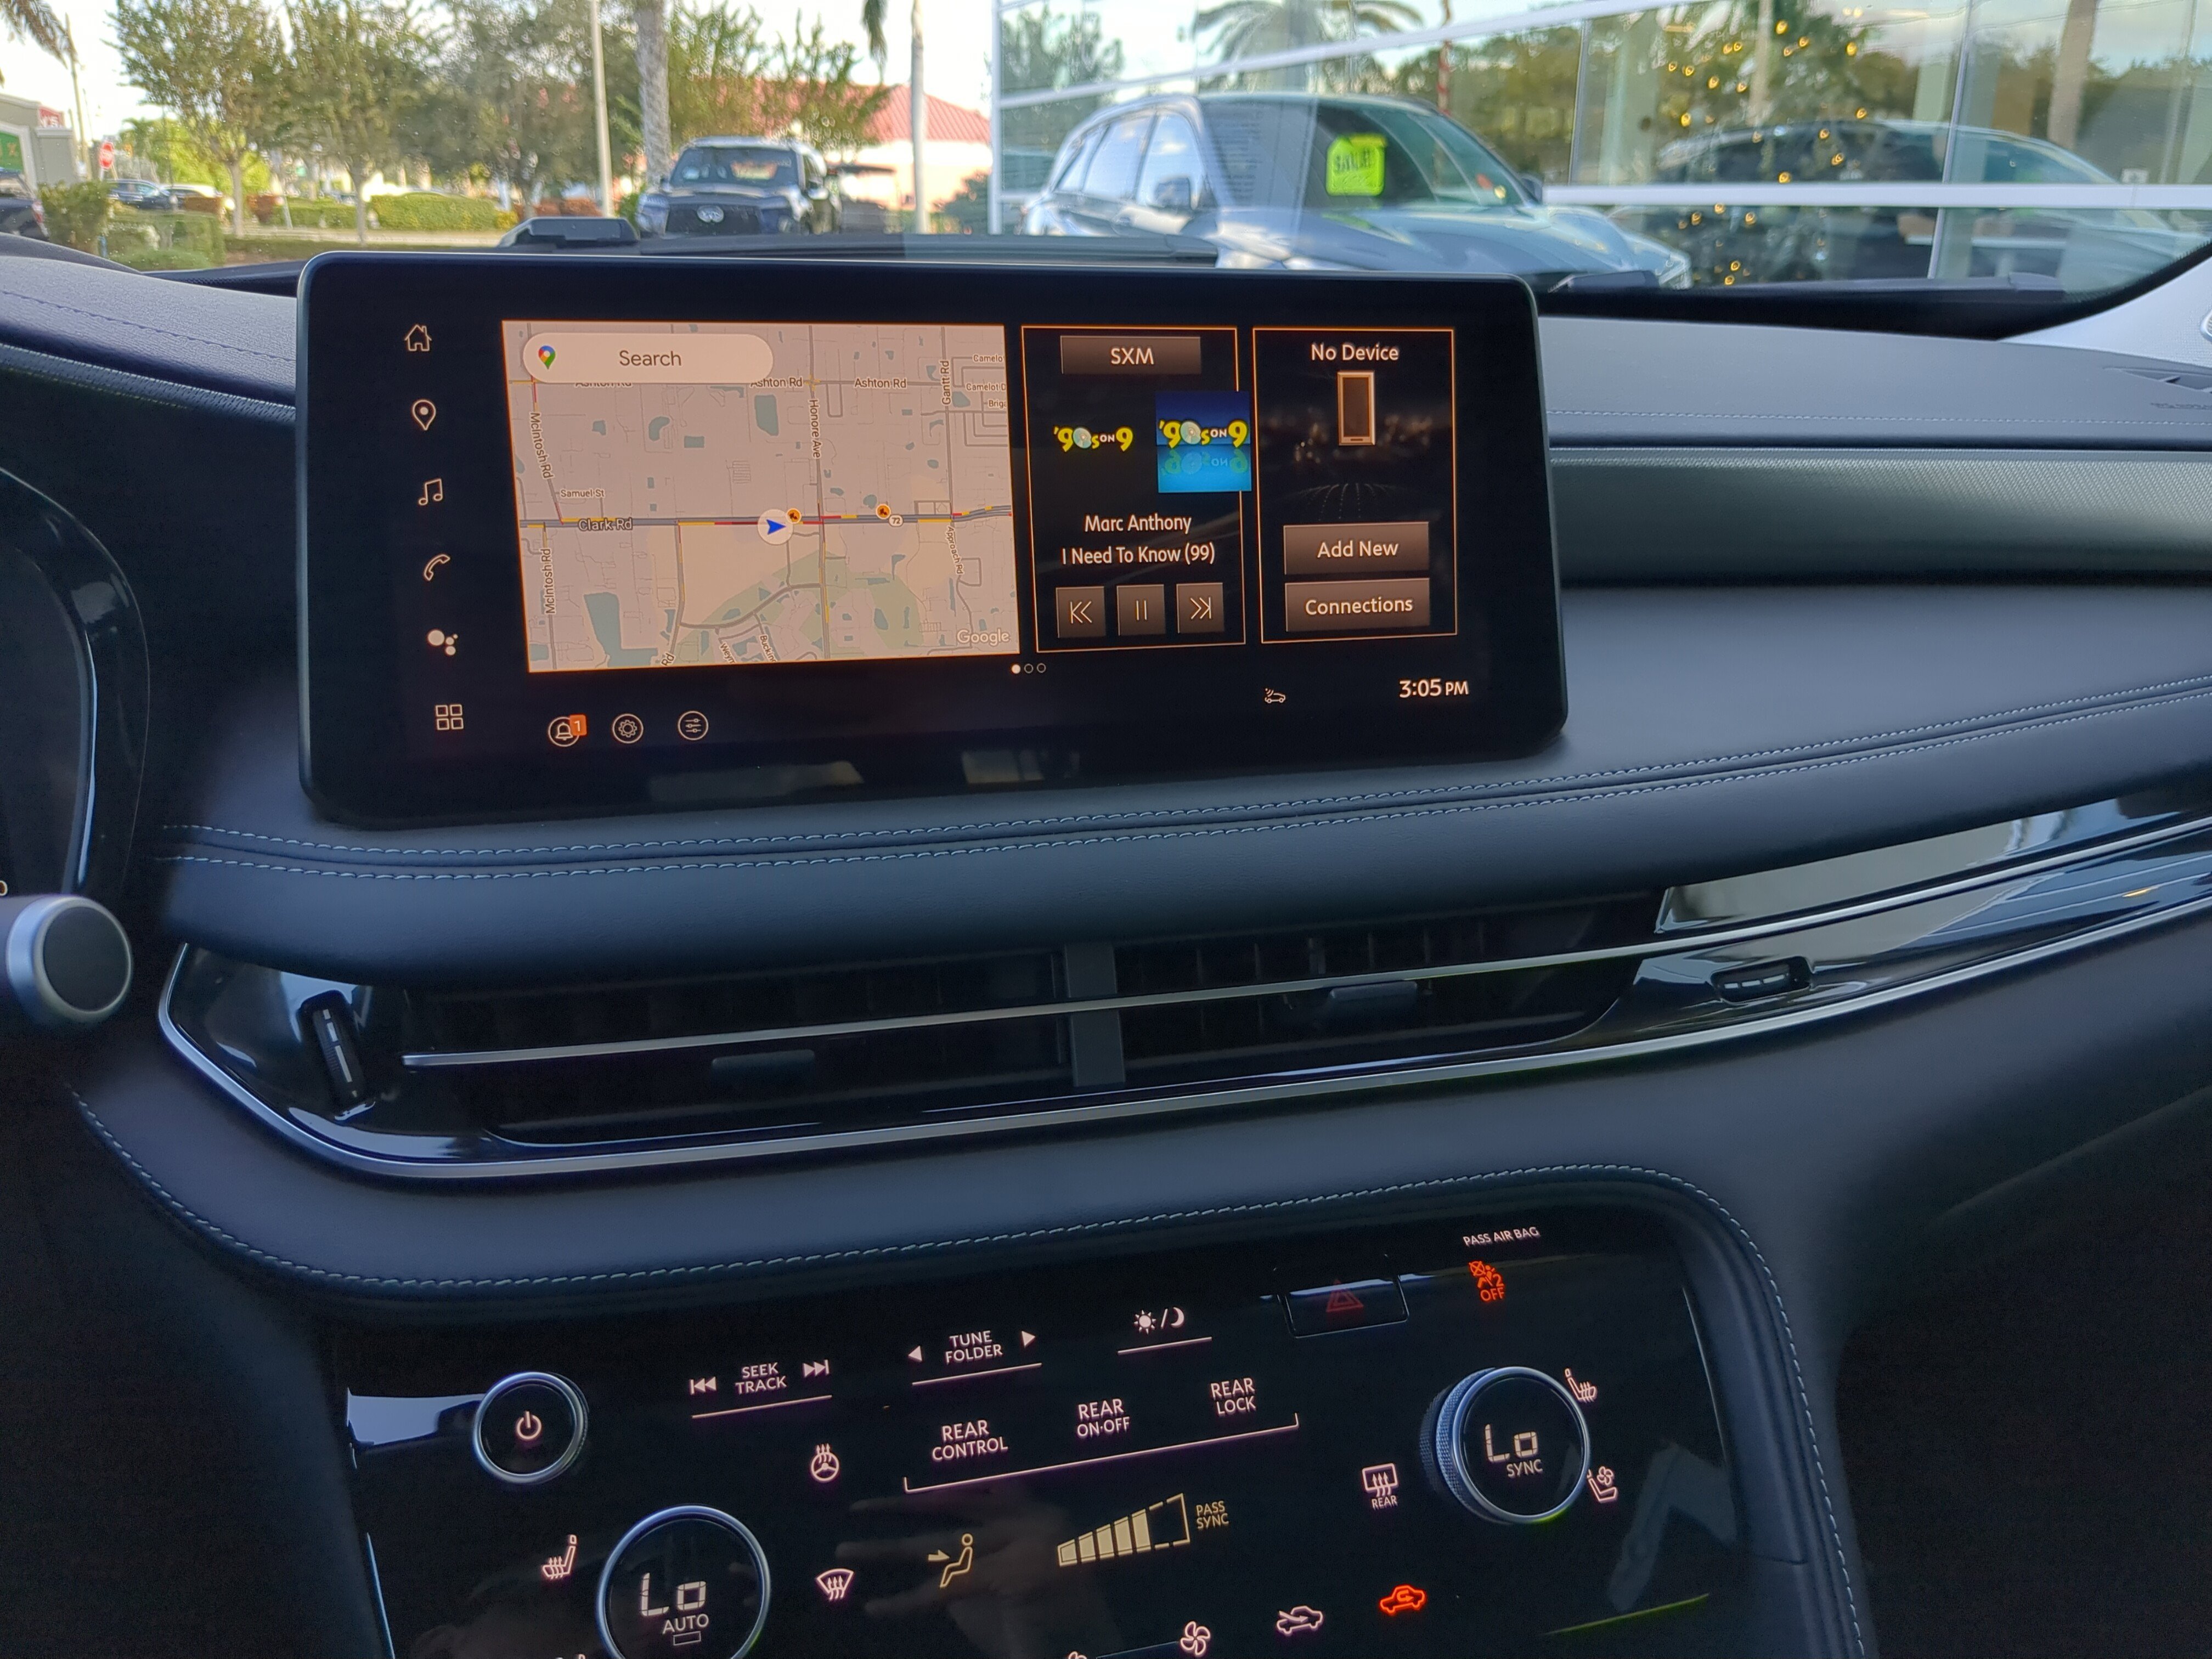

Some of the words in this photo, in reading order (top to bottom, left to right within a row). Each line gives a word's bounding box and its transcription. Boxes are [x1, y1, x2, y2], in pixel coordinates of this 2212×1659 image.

[619, 350, 682, 366] Search
[1111, 348, 1154, 365] SXM
[1311, 342, 1336, 361] No
[1342, 342, 1400, 361] Device
[940, 360, 950, 374] Rd
[789, 377, 803, 387] Rd
[855, 379, 890, 388] Ashton
[893, 379, 907, 388] Rd
[941, 375, 951, 405] Gantt
[810, 399, 820, 438] Honore
[531, 413, 548, 462] McIntosh
[541, 465, 554, 478] Rd
[812, 440, 822, 458] Ave
[561, 489, 593, 498] Samuel
[578, 518, 613, 531] Clark
[615, 517, 633, 530] Rd
[1085, 515, 1123, 532] Marc
[1127, 513, 1192, 534] Anthony
[541, 549, 551, 562] Rd
[947, 527, 961, 562] Approach
[956, 562, 964, 574] Rd
[1072, 546, 1113, 565] Need
[1116, 546, 1134, 563] To
[1138, 546, 1181, 563] Know
[1184, 542, 1215, 565] (99)
[1317, 540, 1353, 558] Add
[1359, 540, 1399, 557] New
[542, 562, 556, 614] McIntosh
[1305, 597, 1413, 616] Connections
[957, 629, 1011, 646] Google
[661, 653, 675, 666] Rd
[1400, 678, 1442, 698] 3:05
[1445, 680, 1469, 696] PM
[1463, 1233, 1492, 1246] PASS
[1493, 1230, 1513, 1243] AIR
[1513, 1226, 1541, 1239] BAG
[1480, 1286, 1505, 1301] OFF
[950, 1330, 992, 1348] TUNE
[945, 1344, 1003, 1364] FOLDER
[742, 1362, 779, 1379] SEEK
[735, 1375, 787, 1394] TRACK
[1211, 1377, 1256, 1399] REAR
[1078, 1398, 1124, 1420] REAR
[1216, 1396, 1256, 1417] LOCK
[942, 1420, 990, 1442] REAR
[932, 1436, 1008, 1462] CONTROL
[1506, 1459, 1543, 1479] SYNC
[1195, 1500, 1226, 1517] PASS
[1371, 1495, 1398, 1510] REAR
[1196, 1513, 1230, 1529] SYNC
[663, 1613, 709, 1634] AUTO
